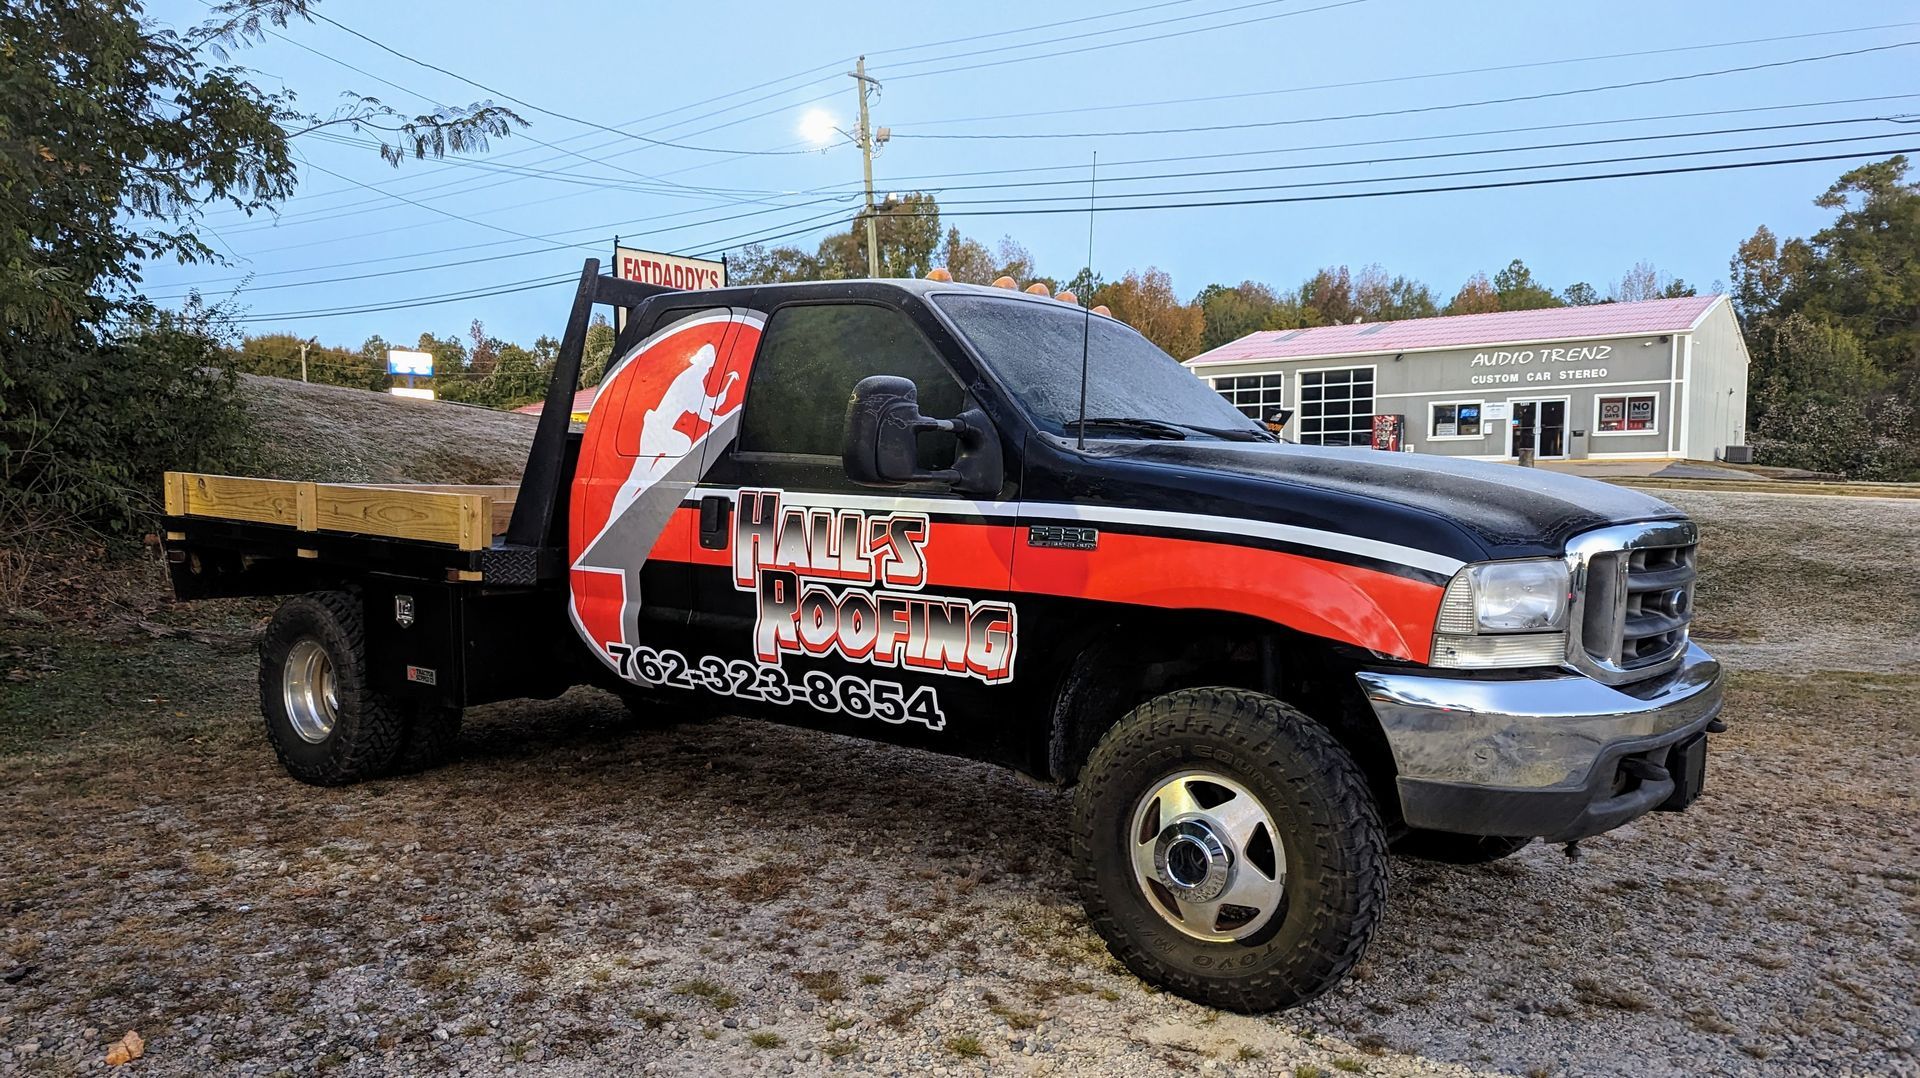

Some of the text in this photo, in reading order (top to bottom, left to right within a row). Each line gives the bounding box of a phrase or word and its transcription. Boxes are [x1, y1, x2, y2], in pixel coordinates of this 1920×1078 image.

[624, 257, 719, 291] FATDADDY'S
[1470, 345, 1612, 368] AUDIO TRENZ
[1471, 368, 1608, 384] CUSTOM CAR STEREO
[1605, 405, 1620, 413] 90
[1632, 402, 1650, 411] NO
[734, 487, 930, 590] HALL'S
[753, 566, 1018, 686] ROOFING
[606, 642, 946, 731] 762-323-8654
